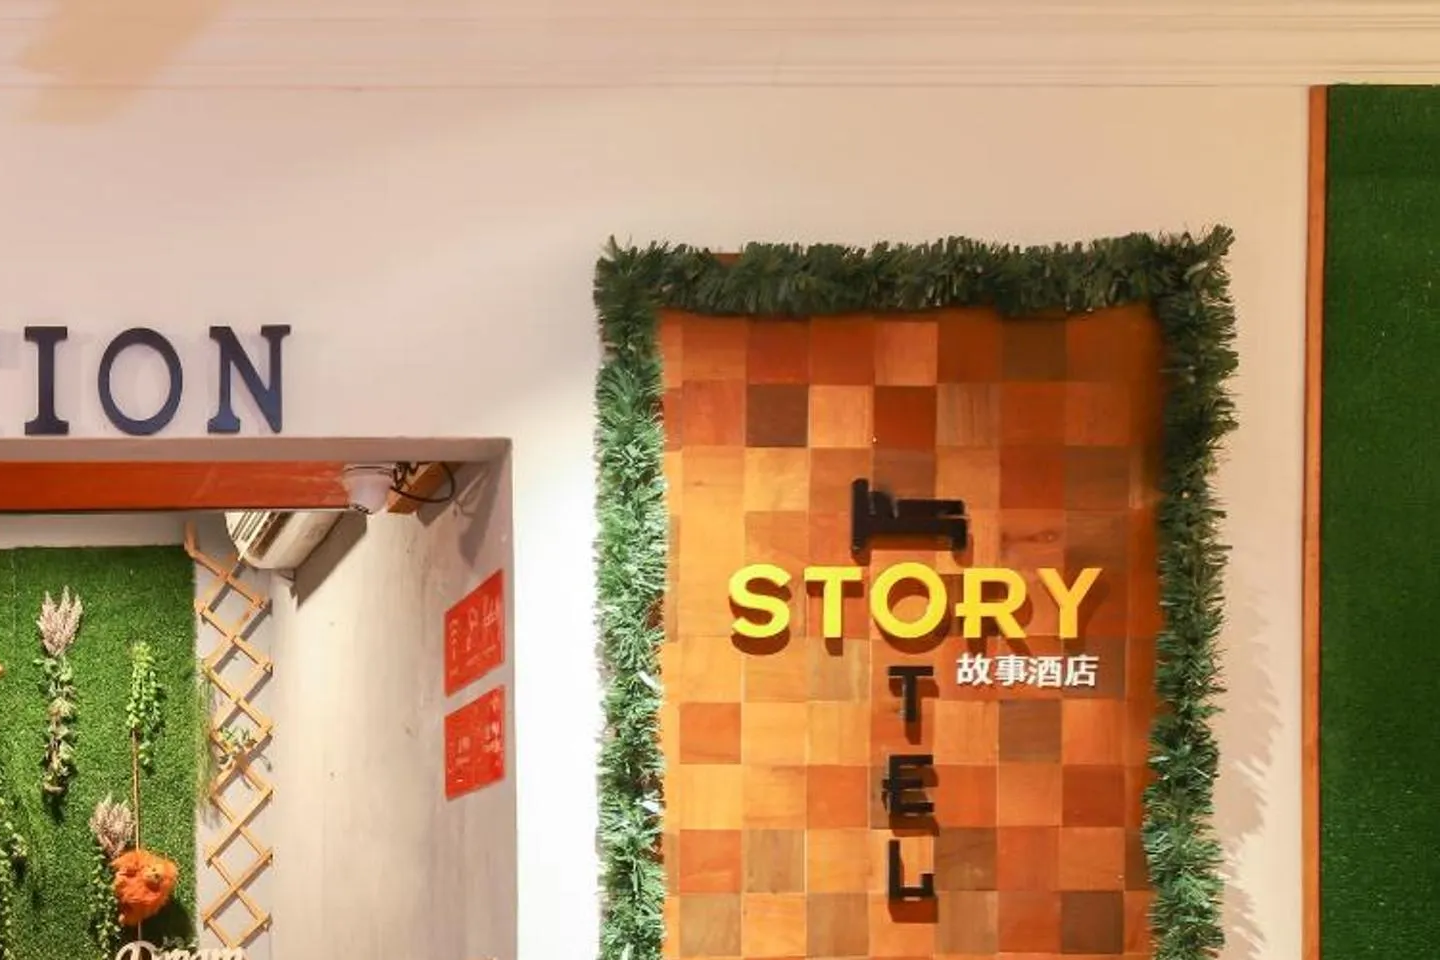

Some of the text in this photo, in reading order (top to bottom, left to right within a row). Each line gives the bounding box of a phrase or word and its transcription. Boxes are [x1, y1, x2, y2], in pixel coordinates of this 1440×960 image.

[728, 562, 1103, 638] STORY
[956, 653, 1100, 687] 故事酒店
[884, 665, 936, 900] TEL
